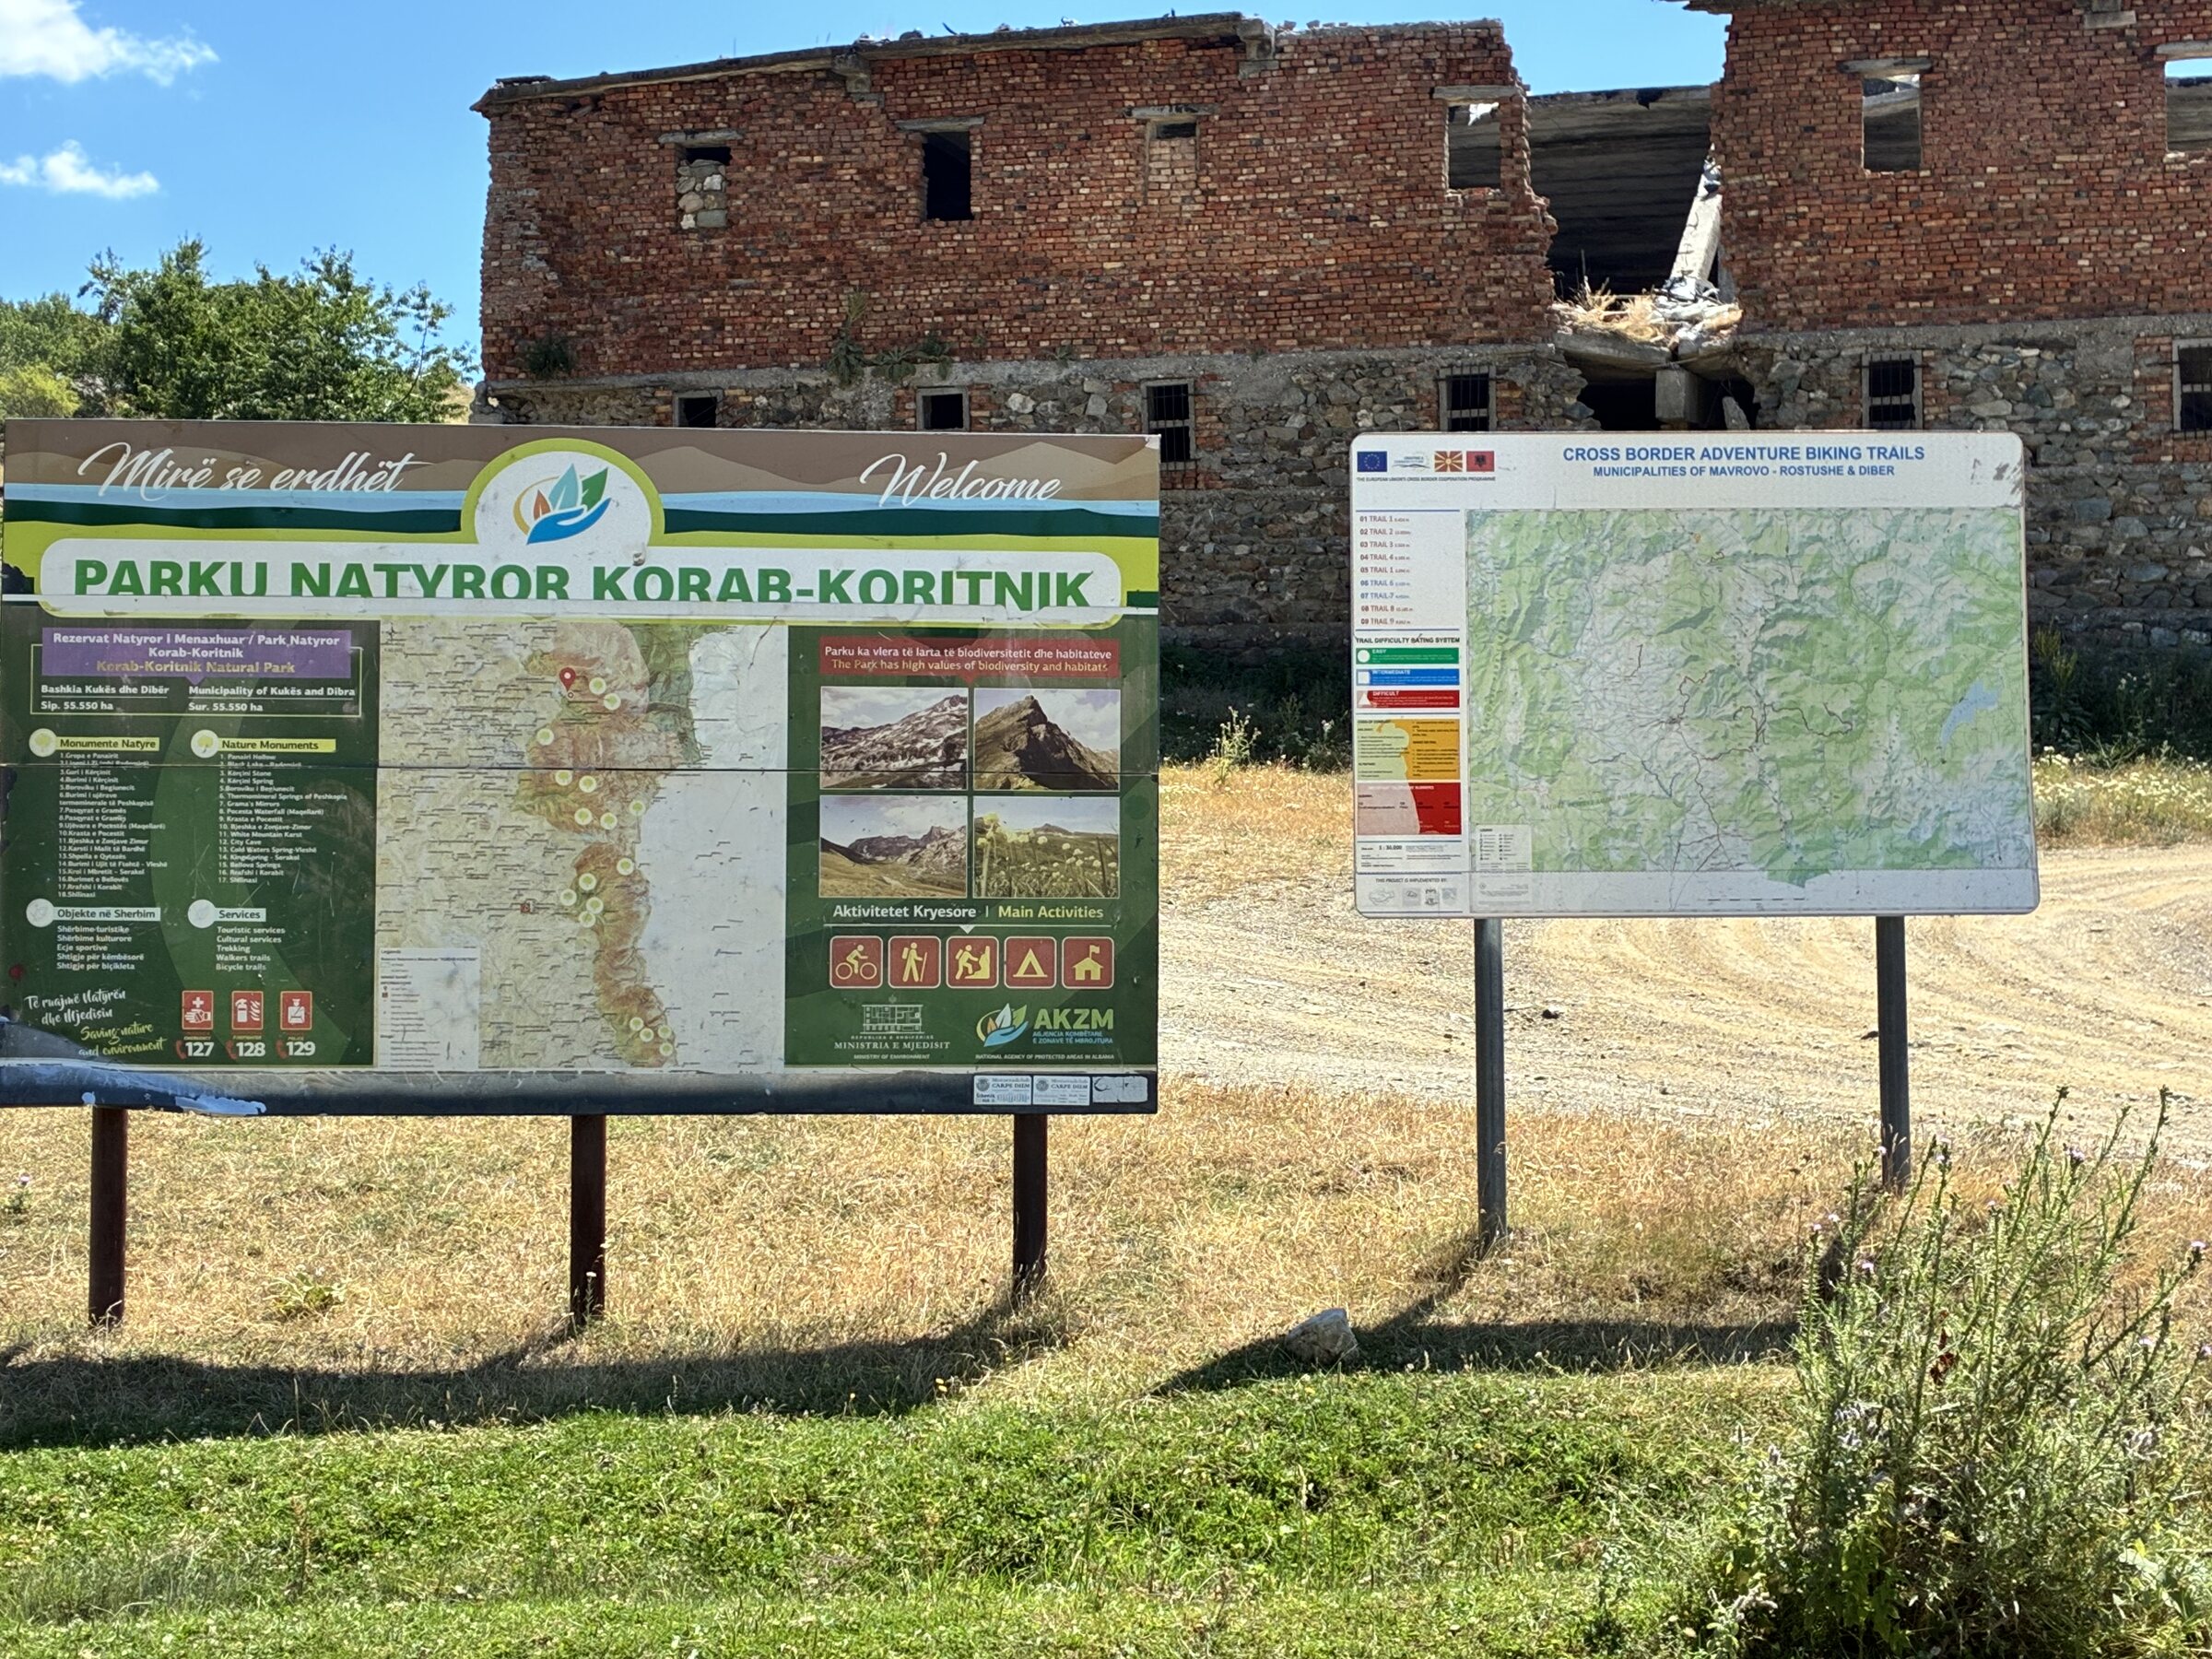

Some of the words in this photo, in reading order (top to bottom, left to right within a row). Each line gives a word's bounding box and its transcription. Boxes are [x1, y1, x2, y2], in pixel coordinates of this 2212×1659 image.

[1563, 447, 1620, 461] CROSS
[1626, 448, 1695, 461] BORDER
[1700, 447, 1801, 461] ADVENTURE
[1806, 447, 1862, 460] BIKING
[1866, 447, 1924, 460] TRAILS
[78, 442, 216, 501] Mirë
[219, 465, 263, 491] se
[270, 452, 435, 494] erdhët
[1594, 466, 1687, 477] MUNICIPALITIES
[1690, 466, 1705, 476] OF
[1710, 465, 1770, 476] MAVROVO
[1780, 465, 1843, 476] ROSTUSHE
[1847, 466, 1855, 476] &
[1859, 465, 1895, 476] DIBER
[859, 452, 1062, 507] Welcome
[75, 559, 267, 596] PARKU
[291, 562, 570, 599] NATYROR
[593, 565, 1094, 611] KORAB-KORITNIK
[53, 633, 109, 643] Rezervat
[112, 633, 163, 645] Natyror
[175, 634, 244, 645] Menaxhuar
[257, 635, 288, 645] Park
[289, 635, 340, 647] Natyror
[148, 647, 243, 658] Korab-Koritnik
[825, 646, 855, 656] Parku
[857, 647, 870, 656] ka
[873, 647, 899, 656] vlera
[902, 648, 913, 656] të
[916, 647, 941, 657] larta
[944, 648, 954, 657] të
[958, 648, 1031, 658] biodiversitetit
[1034, 649, 1053, 658] dhe
[1056, 650, 1112, 659] habitateve
[96, 660, 202, 672] Korab-Koritnik
[206, 662, 259, 673] Natural
[264, 663, 295, 673] Park
[831, 659, 851, 668] The
[854, 660, 877, 669] Park
[880, 660, 899, 669] has
[902, 660, 924, 671] high
[928, 661, 961, 670] values
[965, 661, 976, 670] of
[979, 661, 1040, 673] biodiversity
[1042, 663, 1062, 671] and
[1065, 663, 1108, 672] habitats
[41, 685, 82, 694] Bashkia
[85, 685, 116, 694] Kukës
[119, 685, 138, 694] dhe
[141, 686, 170, 694] Dibër
[189, 686, 253, 697] Municipality
[256, 687, 267, 695] of
[271, 687, 302, 696] Kukës
[304, 688, 324, 696] and
[327, 688, 355, 696] Dibra
[41, 700, 60, 712] Sip.
[64, 701, 98, 710] 55.550
[100, 701, 113, 710] ha
[188, 702, 209, 712] Sur.
[213, 702, 247, 712] 55.550
[250, 703, 264, 712] ha
[60, 739, 119, 747] Monumente
[122, 739, 156, 749] Natyre
[222, 740, 256, 749] Nature
[260, 741, 319, 749] Monuments
[58, 909, 96, 919] Objekte
[100, 909, 111, 918] në
[114, 909, 155, 918] Sherbim
[218, 911, 260, 919] Services
[833, 905, 909, 918] Aktivitetet
[913, 905, 976, 920] Kryesore
[998, 906, 1033, 918] Main
[1038, 906, 1103, 918] Activities
[218, 945, 251, 953] Trekking
[57, 962, 85, 971] Shtigje
[216, 963, 243, 971] Bicycle
[24, 995, 40, 1009] Të
[42, 994, 80, 1011] ruajmë
[41, 1013, 61, 1026] dhe
[1033, 1008, 1113, 1030] AKZM
[80, 1026, 121, 1045] Saving
[121, 1021, 154, 1036] nature
[78, 1045, 100, 1056] and
[102, 1036, 168, 1055] environment
[185, 1041, 214, 1056] 127
[236, 1041, 265, 1056] 128
[286, 1041, 316, 1056] 129
[903, 1041, 951, 1051] MJEDISIT
